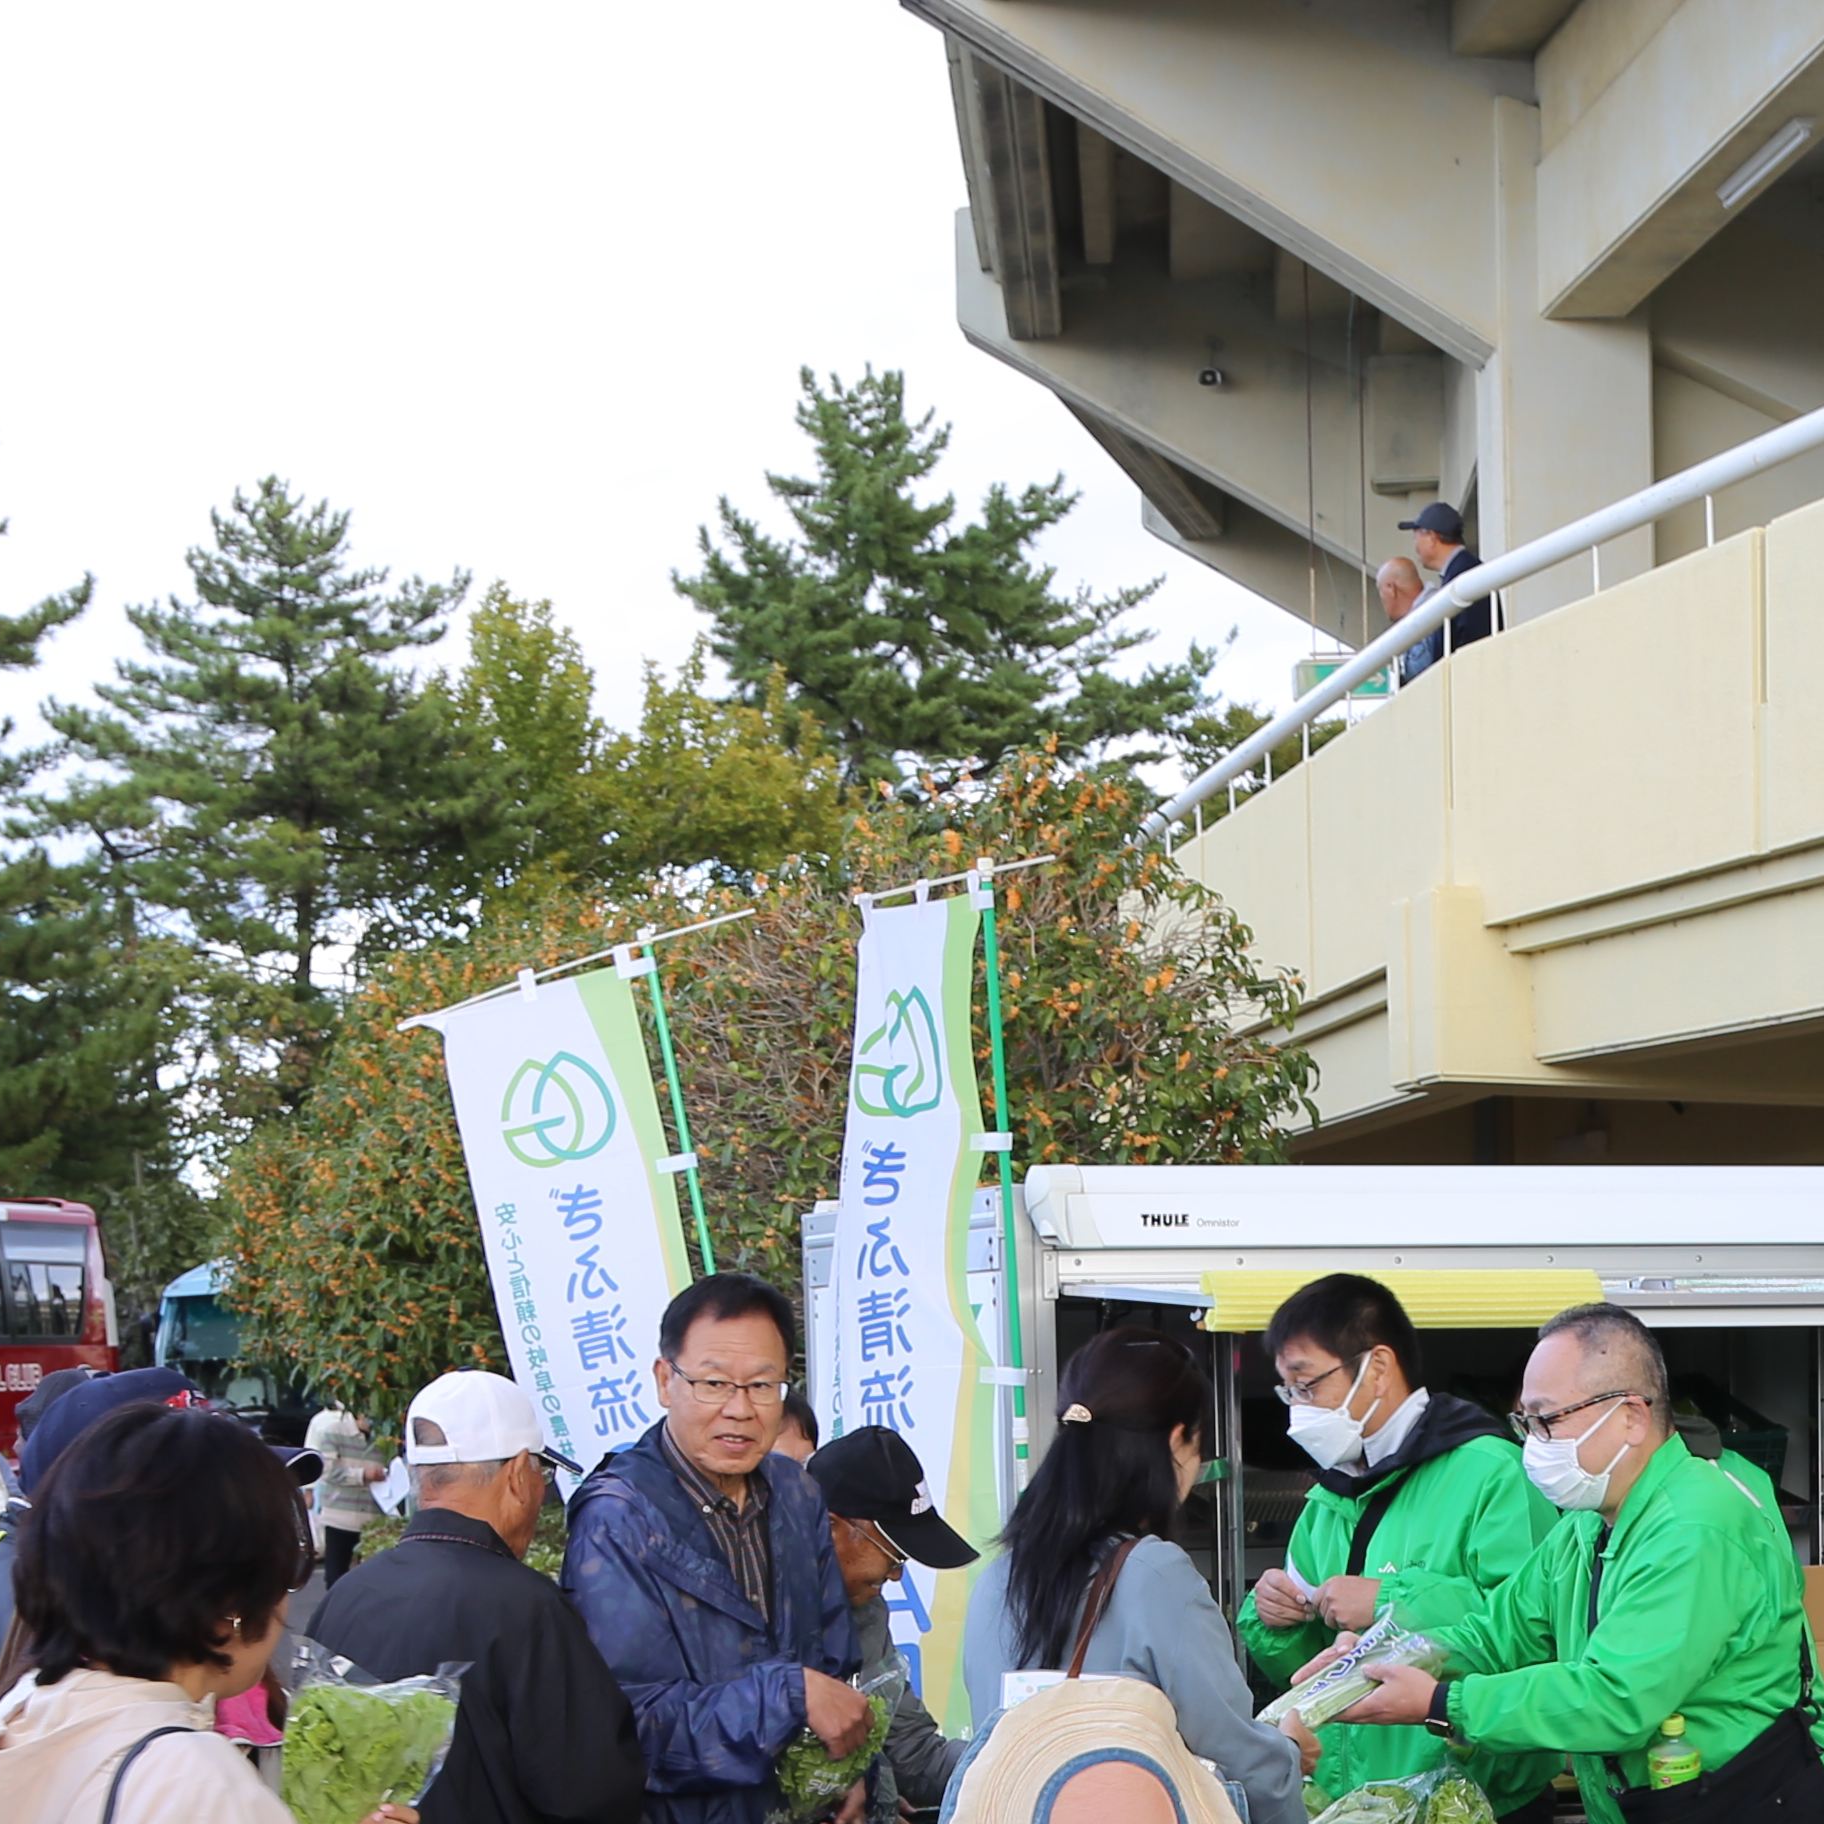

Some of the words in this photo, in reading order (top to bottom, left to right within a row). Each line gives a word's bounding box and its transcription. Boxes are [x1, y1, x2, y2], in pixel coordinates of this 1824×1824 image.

[1140, 1213, 1190, 1227] THULE
[1196, 1217, 1240, 1227] Omnistor
[5, 1363, 43, 1391] CLUB
